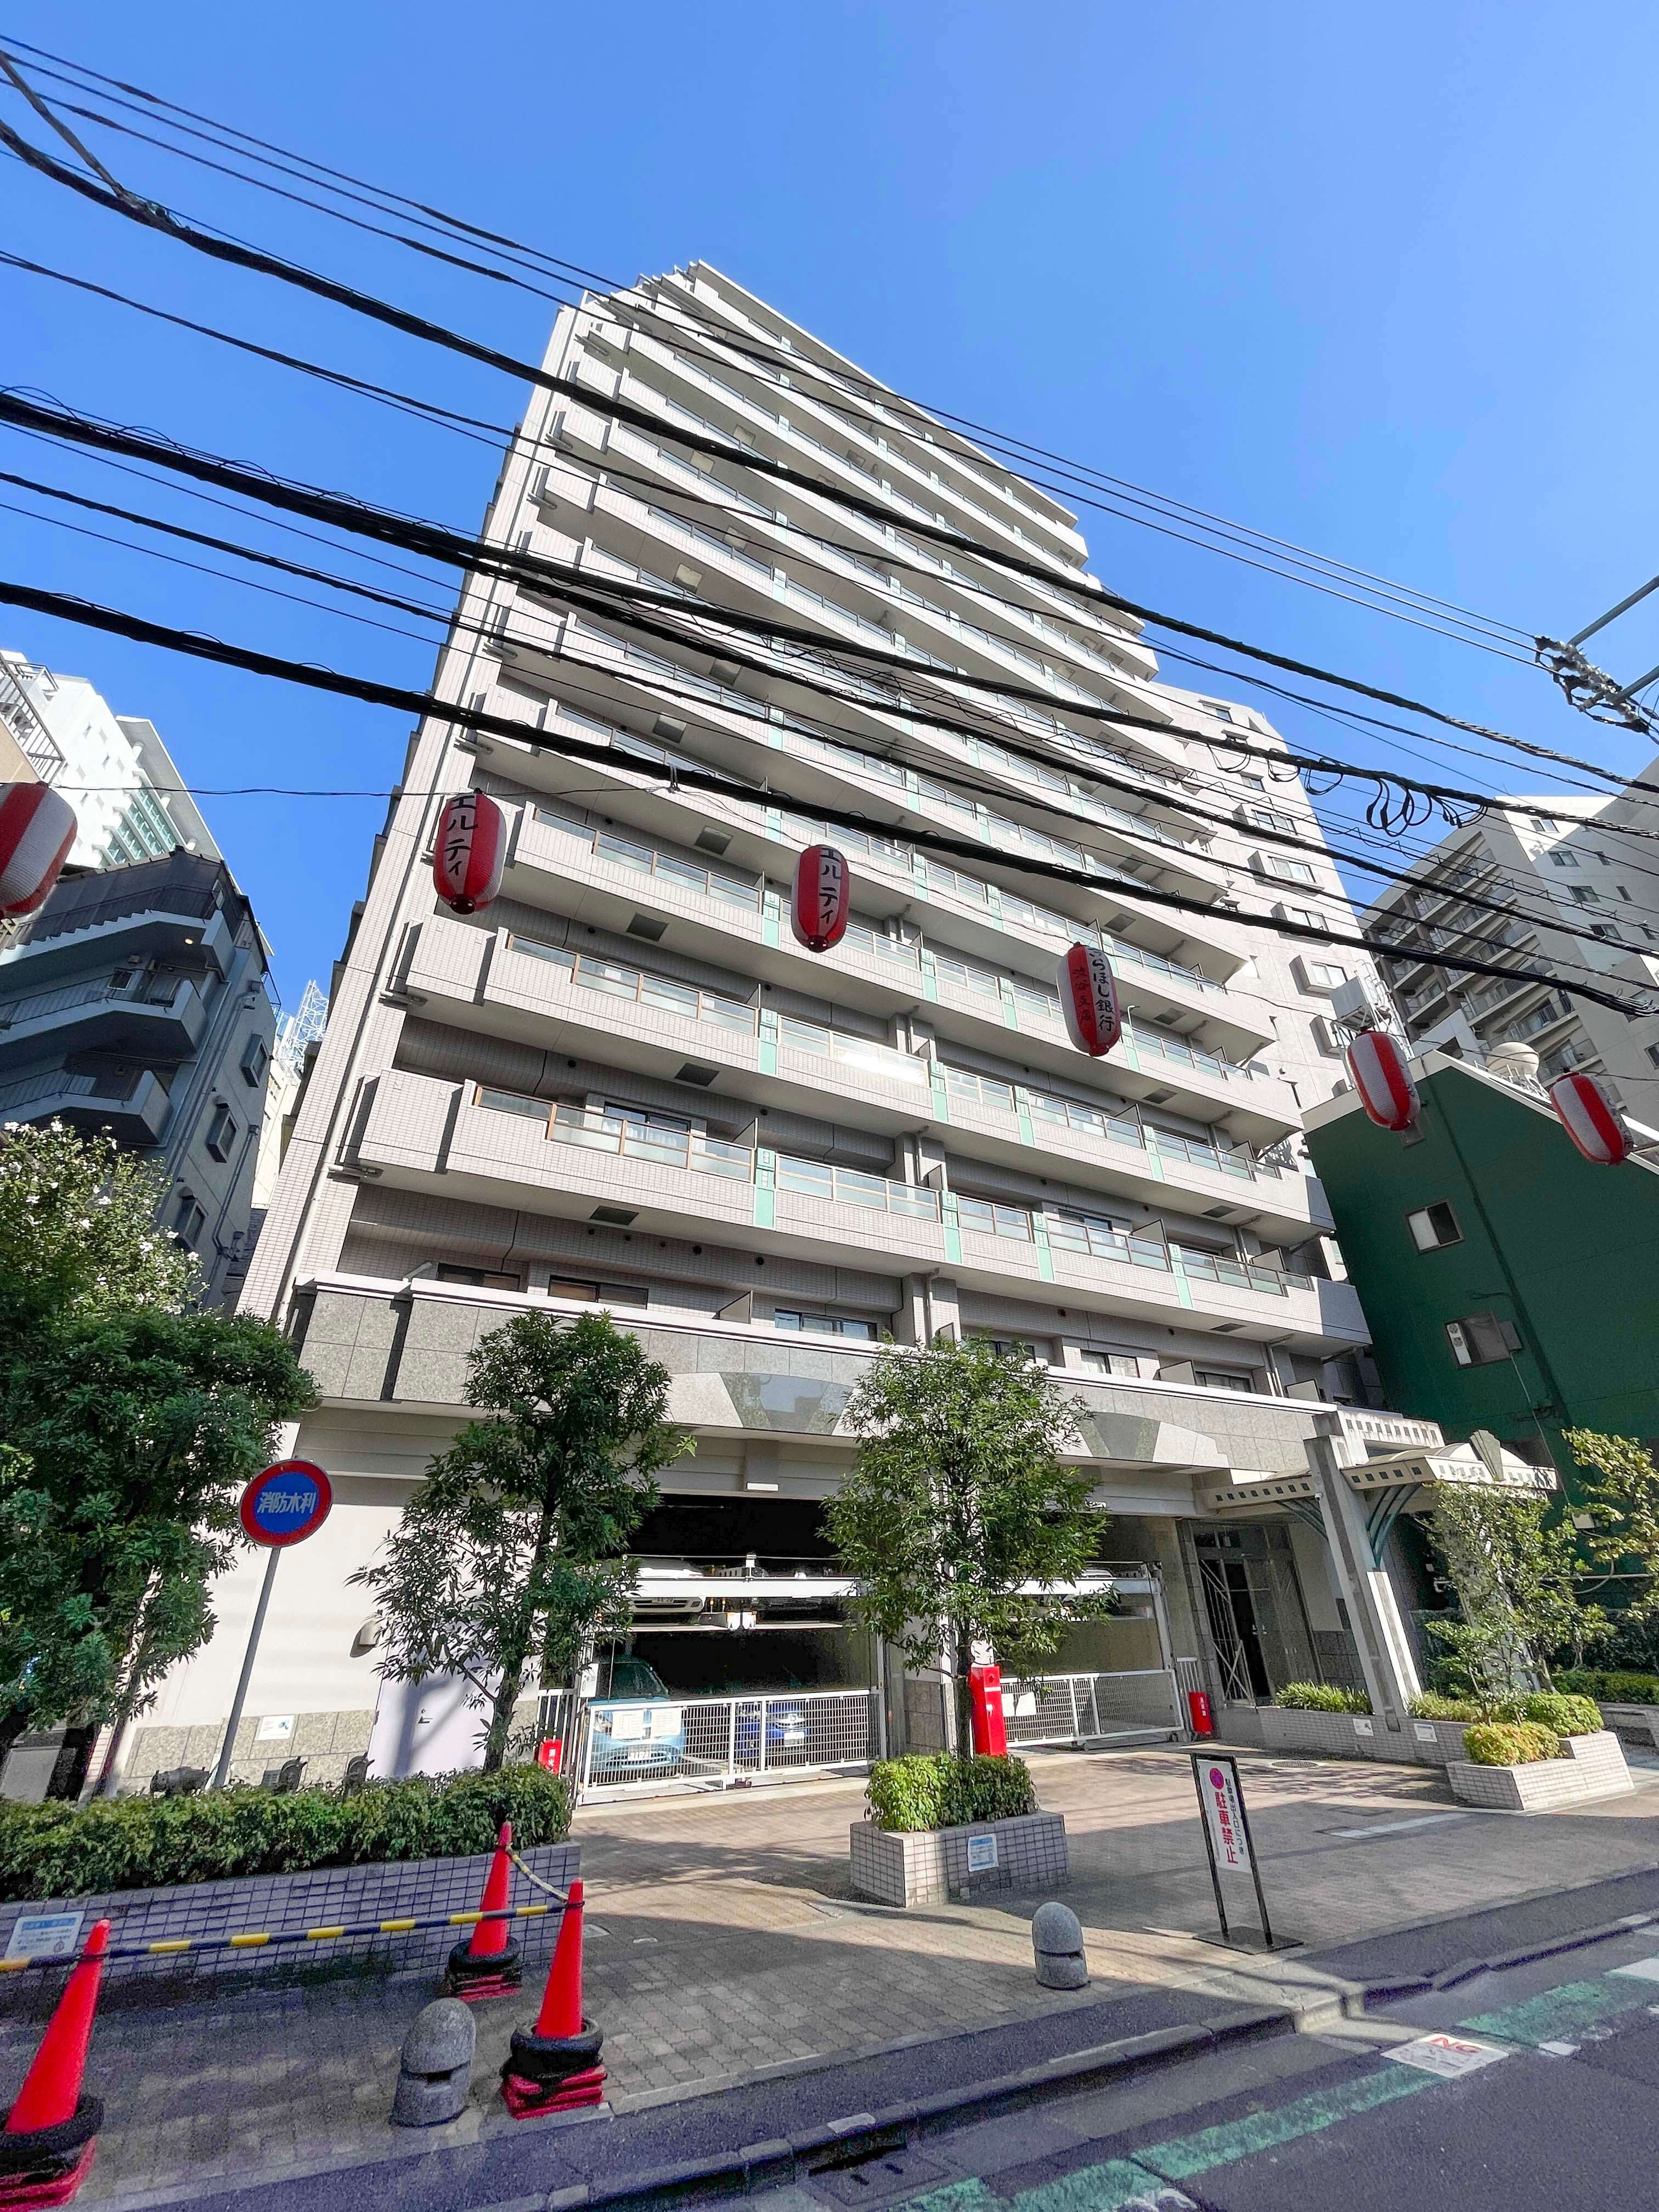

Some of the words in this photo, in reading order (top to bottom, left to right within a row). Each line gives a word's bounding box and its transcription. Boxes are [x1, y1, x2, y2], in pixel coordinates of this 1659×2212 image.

[444, 795, 478, 876] エルティ
[819, 847, 843, 924] エルティ
[256, 1491, 317, 1514] 消防水利
[1214, 1791, 1238, 1865] 駐車禁止
